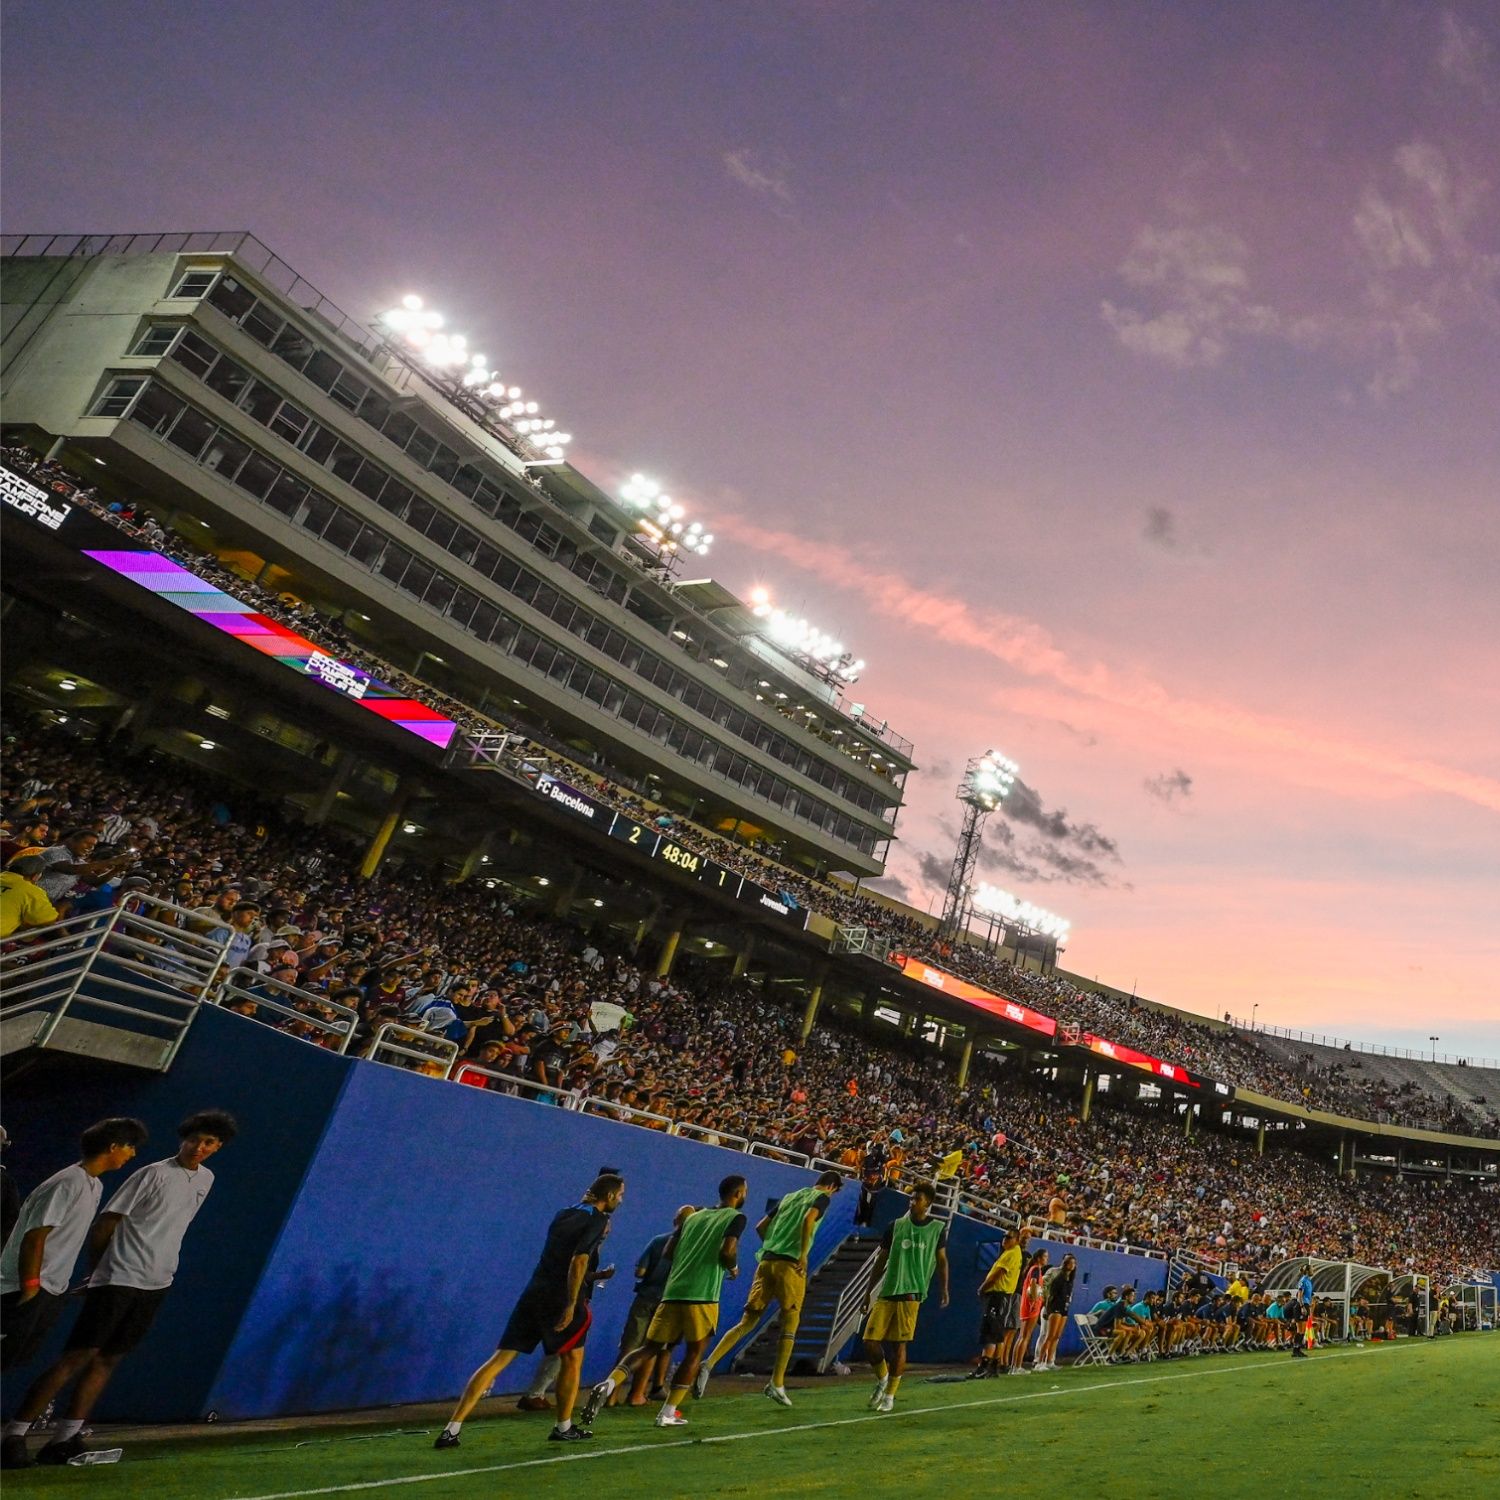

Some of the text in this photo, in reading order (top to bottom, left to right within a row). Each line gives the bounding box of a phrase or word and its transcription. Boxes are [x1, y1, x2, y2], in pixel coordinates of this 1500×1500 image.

[0, 465, 50, 502] OCCER
[0, 479, 67, 522] AMPIONS
[536, 778, 595, 818] FC Barcelona
[629, 826, 641, 844] 2
[662, 844, 699, 872] 48:04
[718, 870, 726, 886] 1
